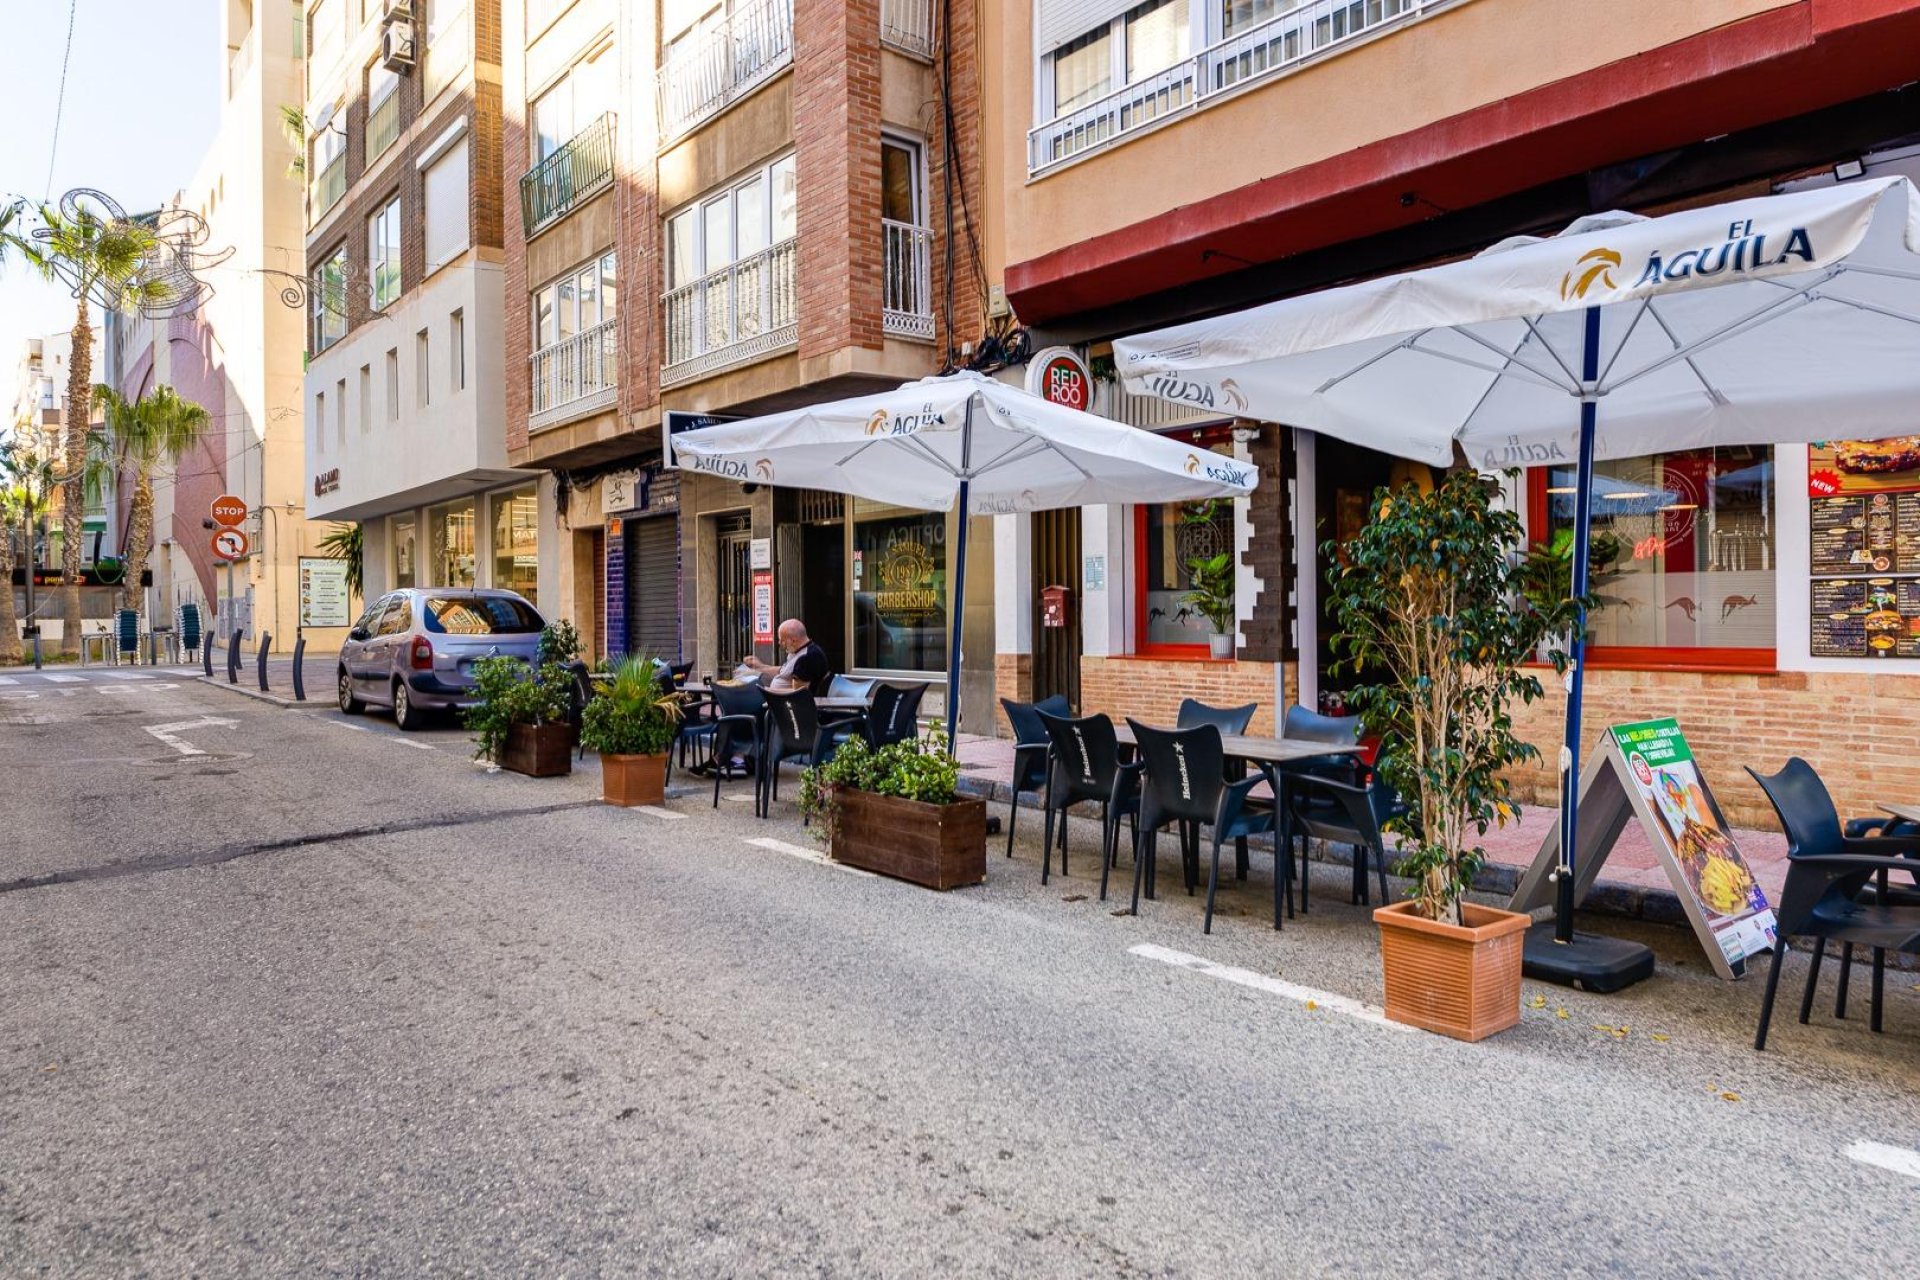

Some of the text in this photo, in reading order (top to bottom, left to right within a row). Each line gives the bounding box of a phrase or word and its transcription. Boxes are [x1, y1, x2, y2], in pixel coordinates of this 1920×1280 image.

[1728, 218, 1755, 240] EL
[1633, 226, 1816, 288] ÁGUILA
[1050, 366, 1081, 388] RED
[1050, 383, 1081, 404] ROO
[1810, 478, 1836, 494] NEW
[215, 506, 244, 515] STOP
[877, 590, 937, 609] BARBERSHOP
[1077, 735, 1091, 777] Heineken
[1177, 753, 1191, 801] Heineken
